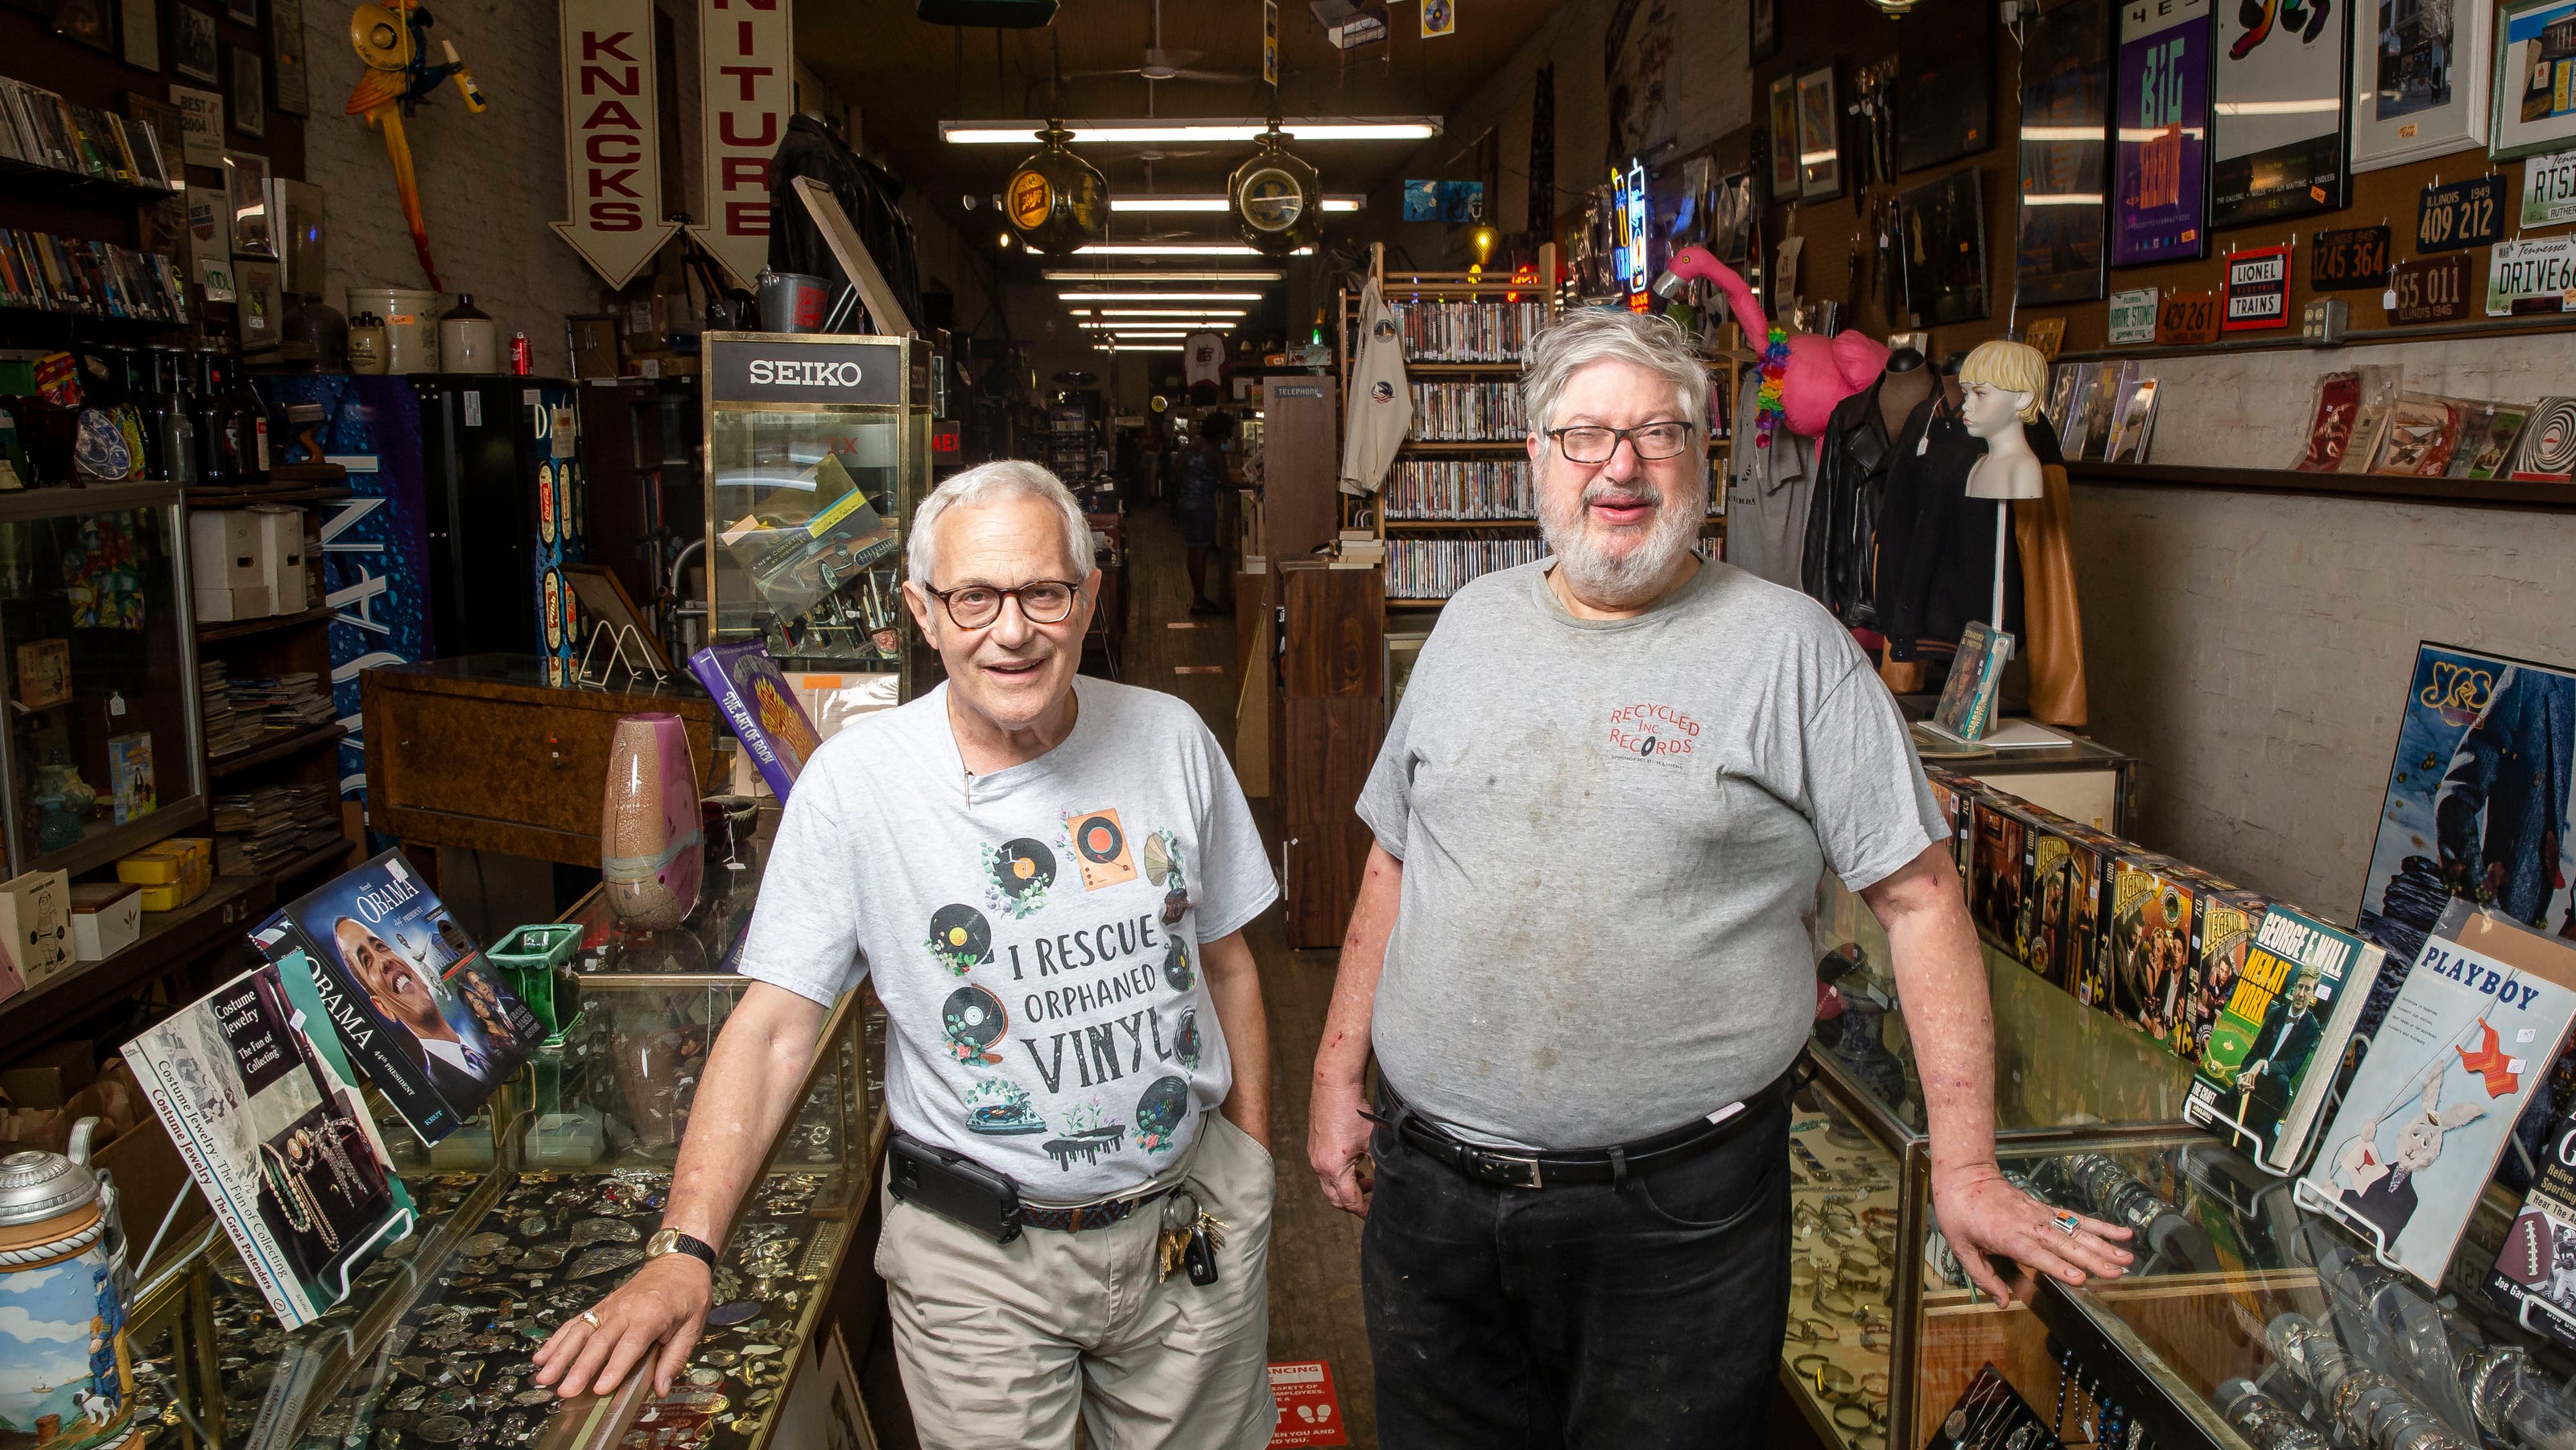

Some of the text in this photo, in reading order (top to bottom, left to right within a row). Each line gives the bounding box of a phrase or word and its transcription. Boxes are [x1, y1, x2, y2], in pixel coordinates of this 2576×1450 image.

[181, 95, 206, 112] BEST
[712, 0, 777, 236] ITURE
[181, 116, 207, 134] 2004
[581, 31, 643, 232] KNACKS
[2225, 192, 2244, 203] CALLING
[2285, 179, 2307, 190] WAITING
[2314, 173, 2336, 184] ENDLESS
[2426, 186, 2491, 207] ILLINOIS 1949
[2420, 199, 2494, 244] 409 212
[2313, 241, 2385, 281] 1245 364
[2499, 243, 2568, 259] MAR Tennessee
[205, 270, 232, 291] KOOL
[2237, 262, 2276, 283] LIONEL
[2427, 266, 2460, 304] 011
[2236, 283, 2277, 295] ELECTRIC
[2110, 304, 2155, 329] ARRIVE STONED
[2164, 301, 2214, 331] 429 261
[2236, 295, 2275, 315] TRAINS
[2398, 304, 2453, 320] ILLINOIS 1946
[749, 360, 862, 387] SEIKO
[1278, 387, 1320, 395] TELEPHONE
[758, 555, 772, 567] NEW
[772, 532, 803, 556] CORVETTE
[779, 538, 807, 559] CHEVROLET
[723, 690, 775, 765] THE ART OF ROCK
[1611, 703, 1700, 737] RECYCLED
[1609, 728, 1692, 757] RECORDS
[2027, 830, 2035, 850] 1000
[2106, 861, 2115, 884] 1000
[356, 878, 419, 924] OBAMA
[2116, 874, 2148, 909] LEGENDS
[402, 906, 424, 924] PRESIDENT
[2194, 899, 2203, 919] 750
[2204, 911, 2243, 949] LEGENDS
[1007, 913, 1158, 981] I RESCUE
[2257, 911, 2310, 960] GEORGE
[2301, 930, 2320, 964] F.
[2313, 934, 2351, 979] WILL
[2268, 960, 2293, 995] AT
[2421, 946, 2539, 1011] PLAYBOY
[214, 990, 258, 1021] Costume
[304, 956, 374, 1050] OBAMA
[1024, 964, 1156, 1023] ORPHANED
[2230, 977, 2274, 1024] WORK
[222, 1008, 259, 1039] Jewelry
[515, 1010, 535, 1031] MAKES
[237, 1031, 273, 1062] The Fun of
[246, 1047, 280, 1075] Collecting
[1020, 1005, 1173, 1094] VINYL
[374, 1049, 416, 1097] 44th PRESIDENT
[2192, 1080, 2218, 1105] THE CRAFT
[423, 1109, 444, 1127] KRUT
[157, 1060, 288, 1279] Costume Jewelry: The Fun of Collecting
[2546, 1163, 2574, 1185] Relive
[151, 1088, 273, 1291] Costume Jewelry The Great Pretenders
[2541, 1177, 2576, 1206] Sporting
[2533, 1194, 2567, 1219] Hear The
[2495, 1276, 2509, 1291] Joe
[1289, 1430, 1311, 1438] YOU
